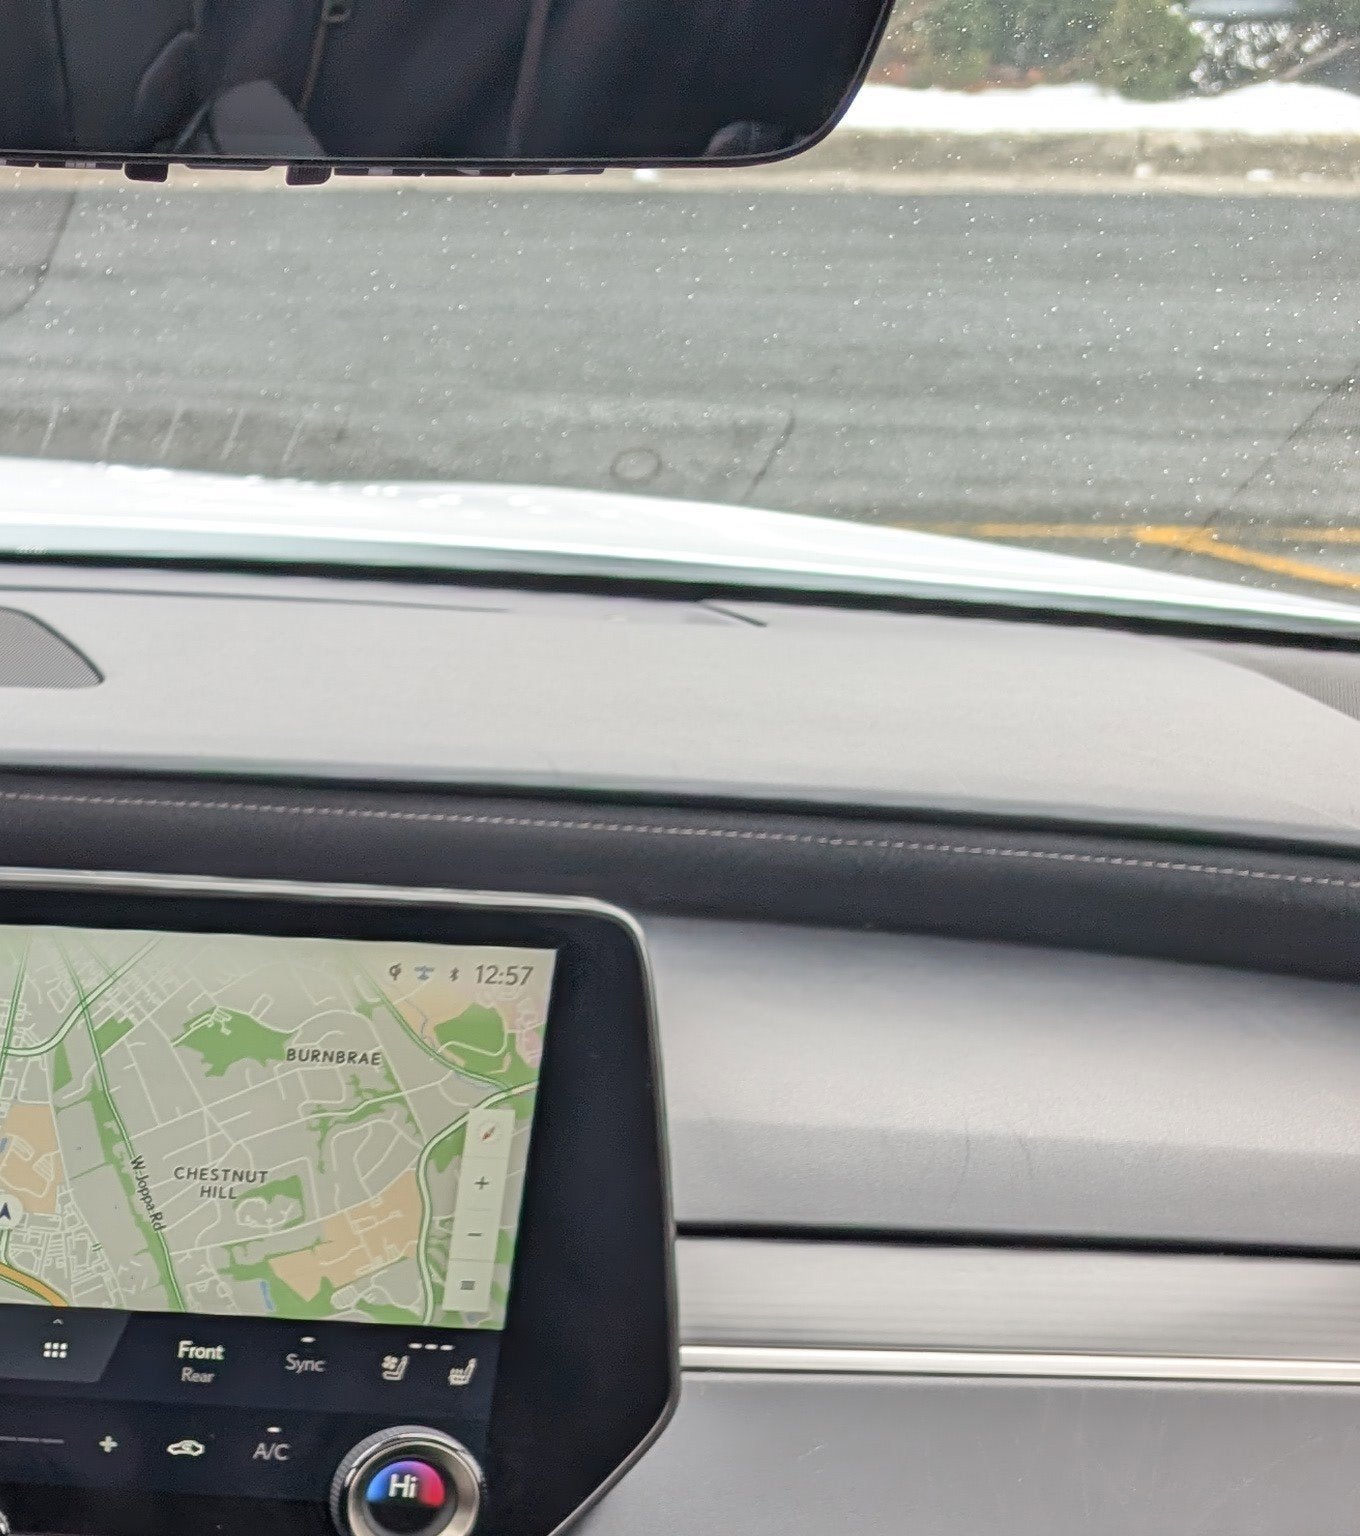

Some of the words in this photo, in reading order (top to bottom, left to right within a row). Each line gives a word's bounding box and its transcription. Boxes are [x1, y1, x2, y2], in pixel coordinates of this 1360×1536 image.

[476, 964, 534, 986] 12:57
[286, 1048, 381, 1067] BURNBRAE
[130, 1155, 146, 1170] W
[174, 1166, 268, 1184] CHESTNUT
[136, 1175, 155, 1211] Joppa
[200, 1185, 238, 1201] HILL
[149, 1212, 167, 1232] Rd
[178, 1340, 224, 1361] Front
[285, 1353, 326, 1374] Sync
[181, 1367, 215, 1384] Rear
[253, 1442, 290, 1461] A/C
[388, 1474, 418, 1499] Hi
